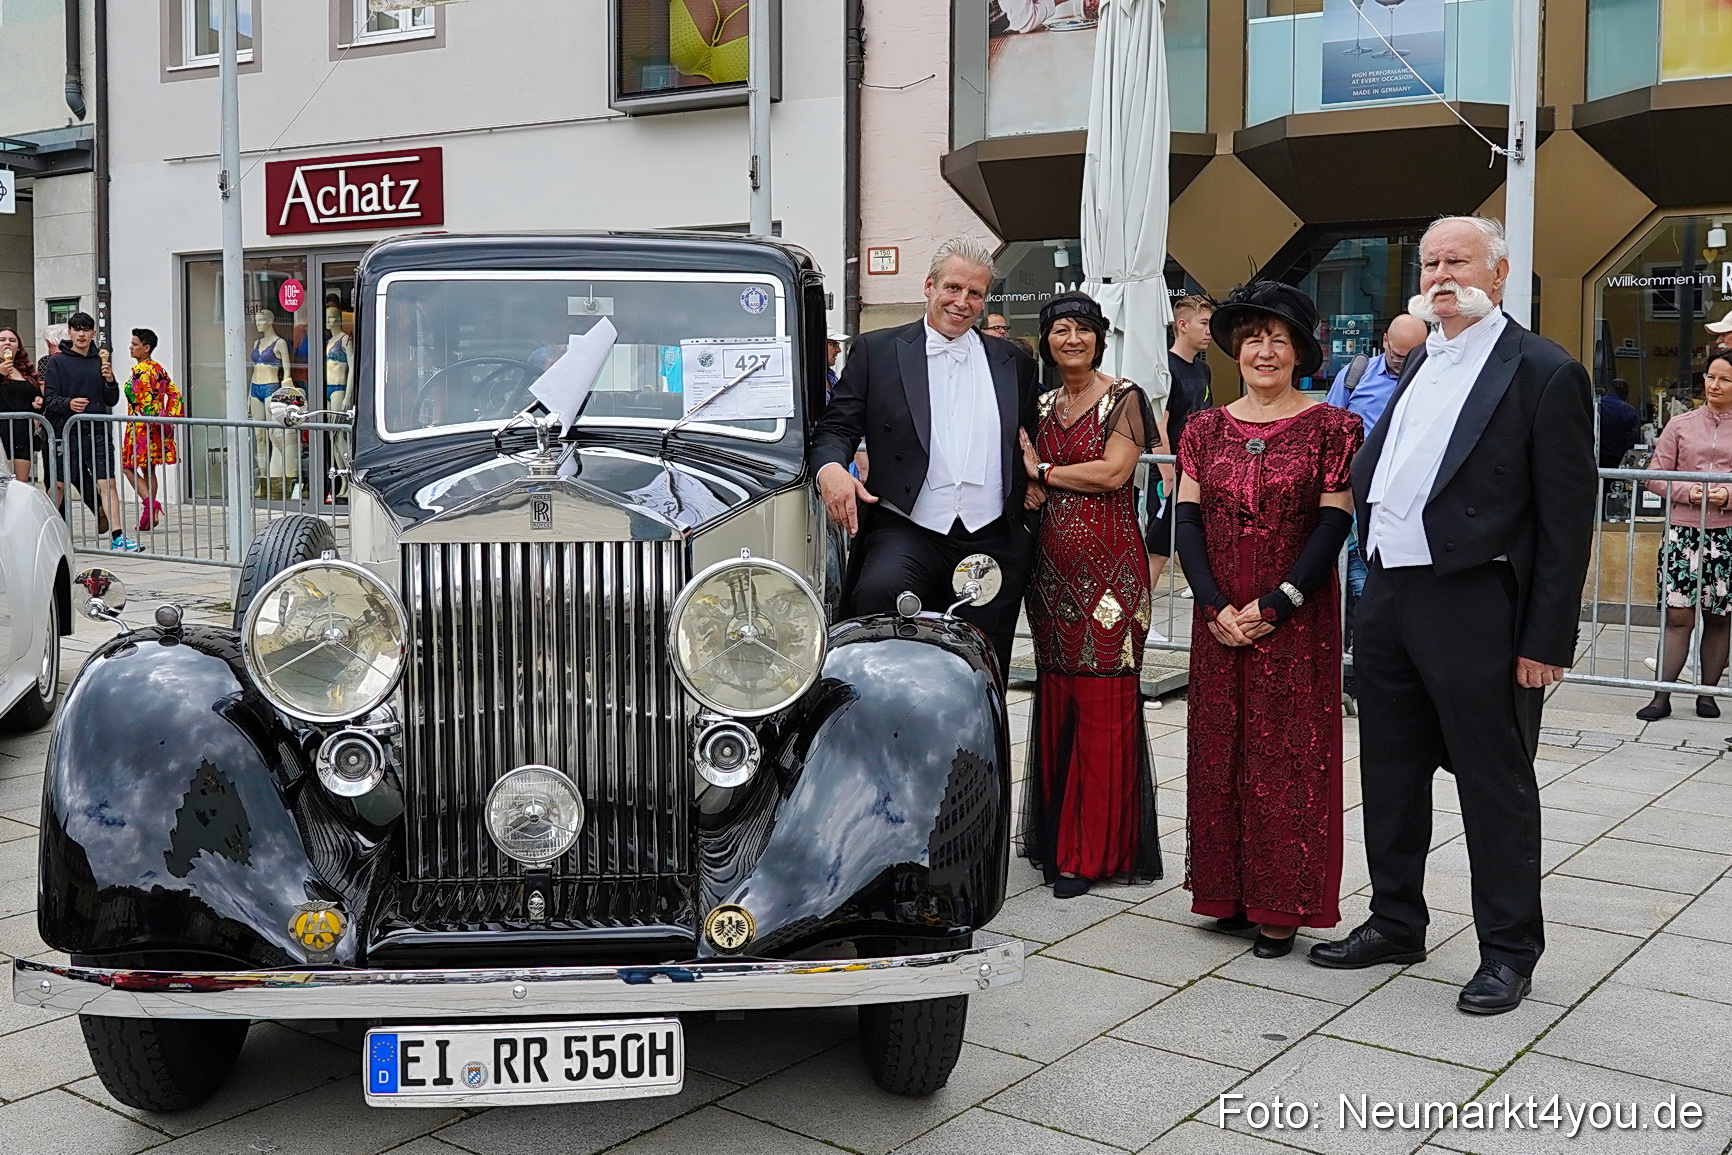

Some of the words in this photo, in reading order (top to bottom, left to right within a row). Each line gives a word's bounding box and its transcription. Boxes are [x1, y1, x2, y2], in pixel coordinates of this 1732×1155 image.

[1368, 67, 1413, 77] PERFORMANC
[1381, 74, 1414, 82] OCCASION
[1352, 88, 1371, 96] MADE
[1380, 85, 1412, 93] GERMANY
[278, 166, 421, 226] Achatz
[1606, 273, 1695, 288] Willkommen
[1698, 272, 1716, 284] im
[244, 303, 265, 314] hatz
[734, 354, 772, 372] 427
[378, 1069, 389, 1084] D
[400, 1039, 454, 1087] EI
[493, 1036, 549, 1084] RR
[563, 1030, 675, 1082] 550H
